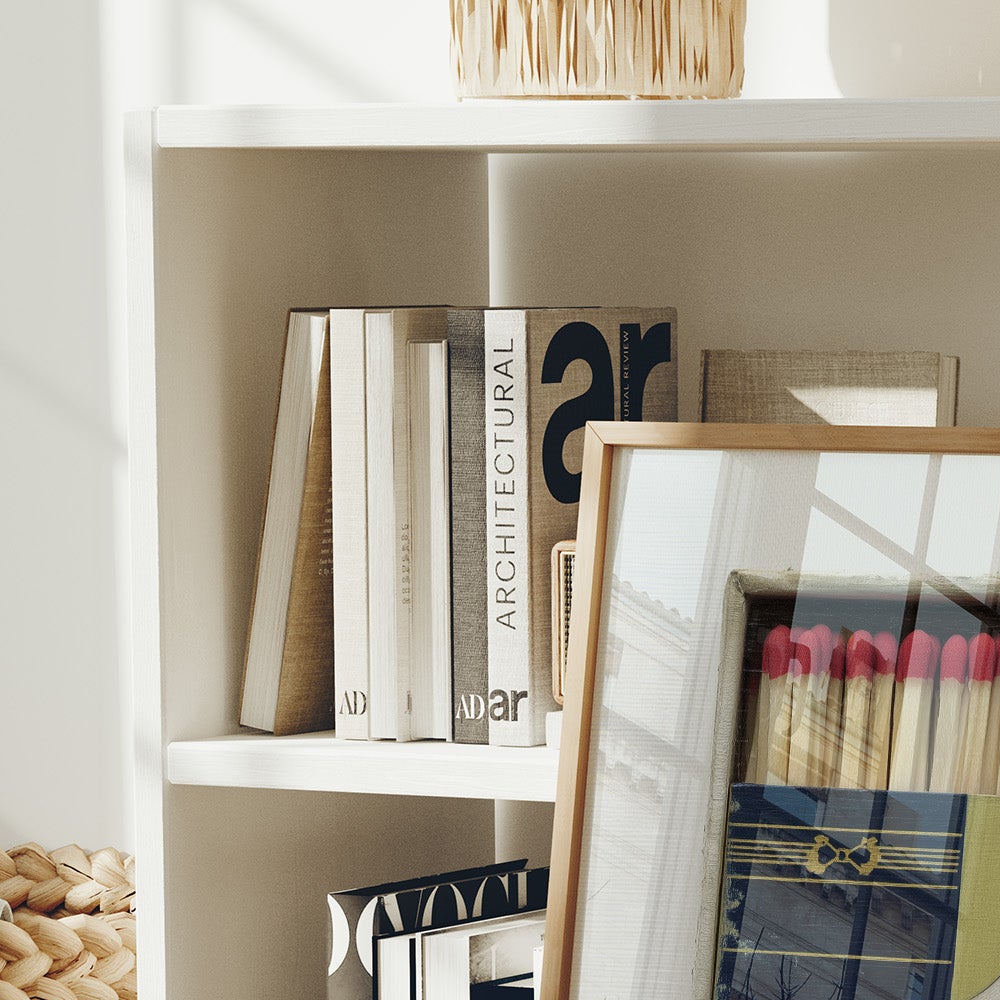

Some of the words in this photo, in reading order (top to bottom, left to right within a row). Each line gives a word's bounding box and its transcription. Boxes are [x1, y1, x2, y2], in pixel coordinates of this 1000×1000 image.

[541, 321, 671, 504] ar
[493, 338, 516, 630] ARCHITECTURAL
[339, 690, 367, 715] AD
[456, 694, 485, 719] AD
[489, 689, 528, 721] ar
